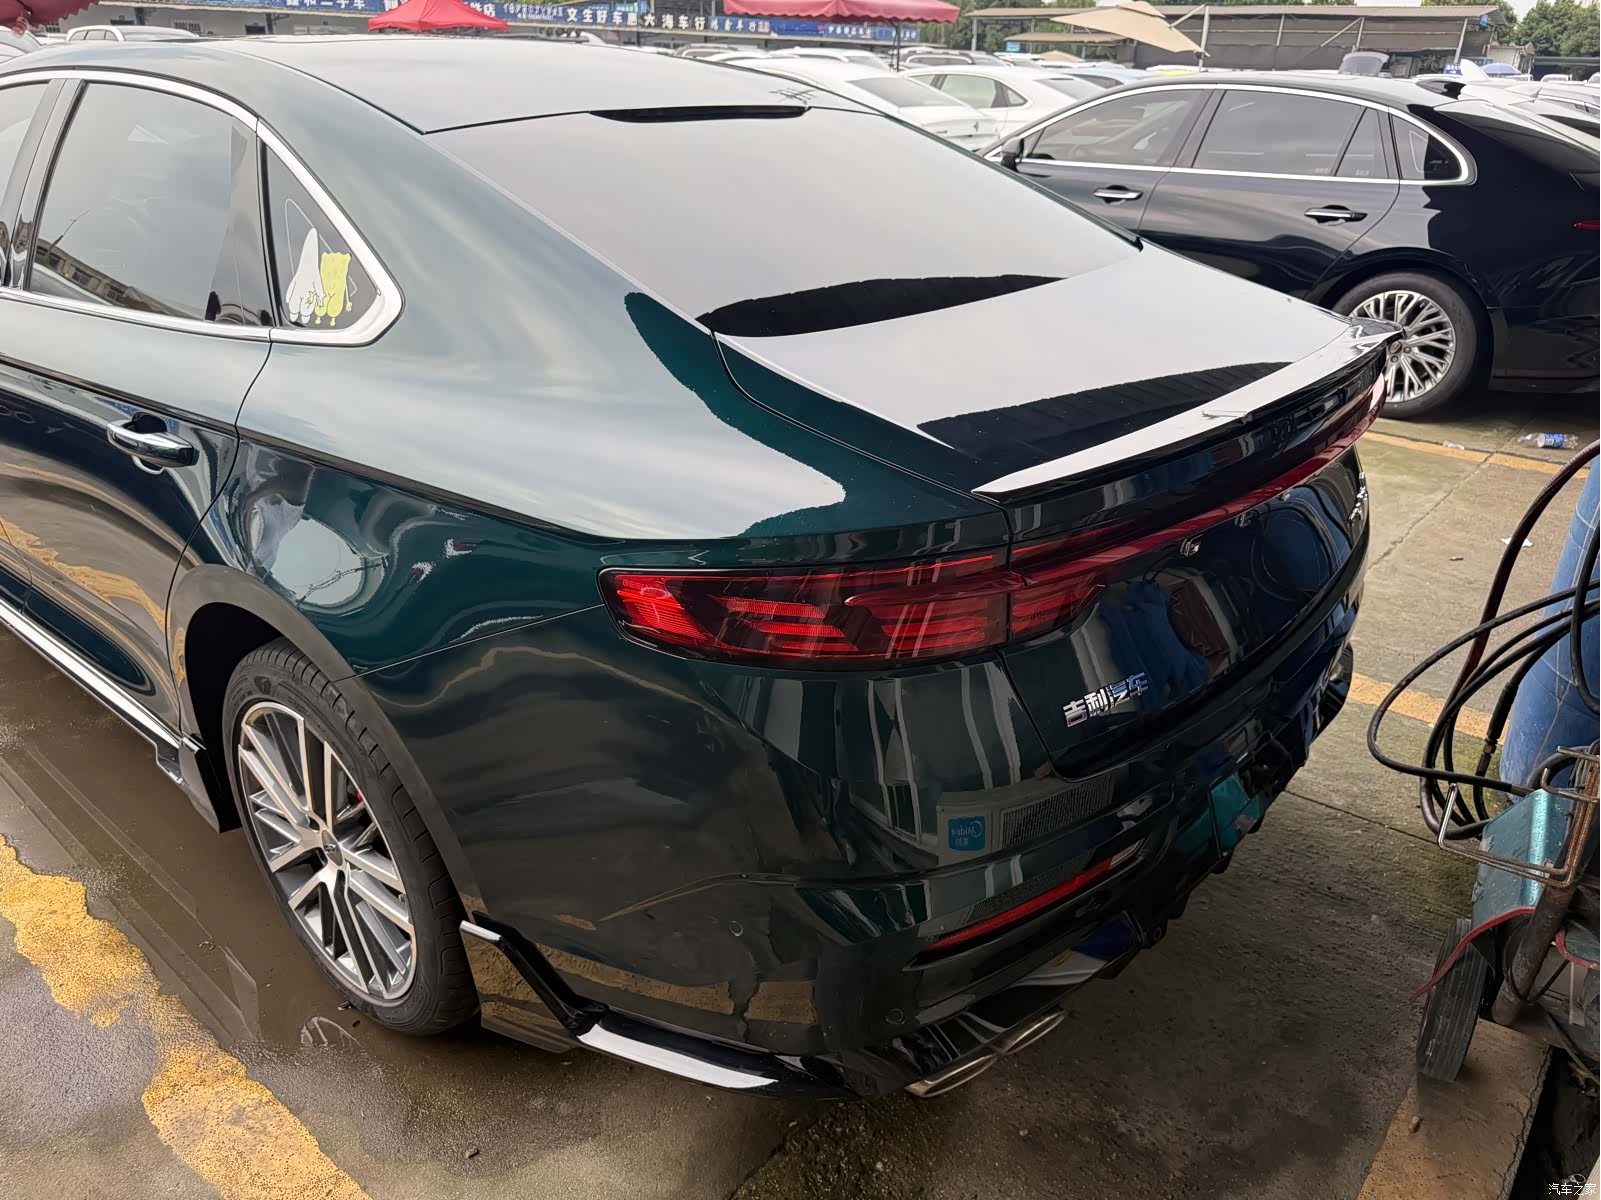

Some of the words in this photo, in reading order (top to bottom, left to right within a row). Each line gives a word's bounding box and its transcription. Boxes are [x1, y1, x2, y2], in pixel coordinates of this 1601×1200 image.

[644, 13, 706, 31] 大海车行
[1063, 672, 1149, 727] 吉利汽车
